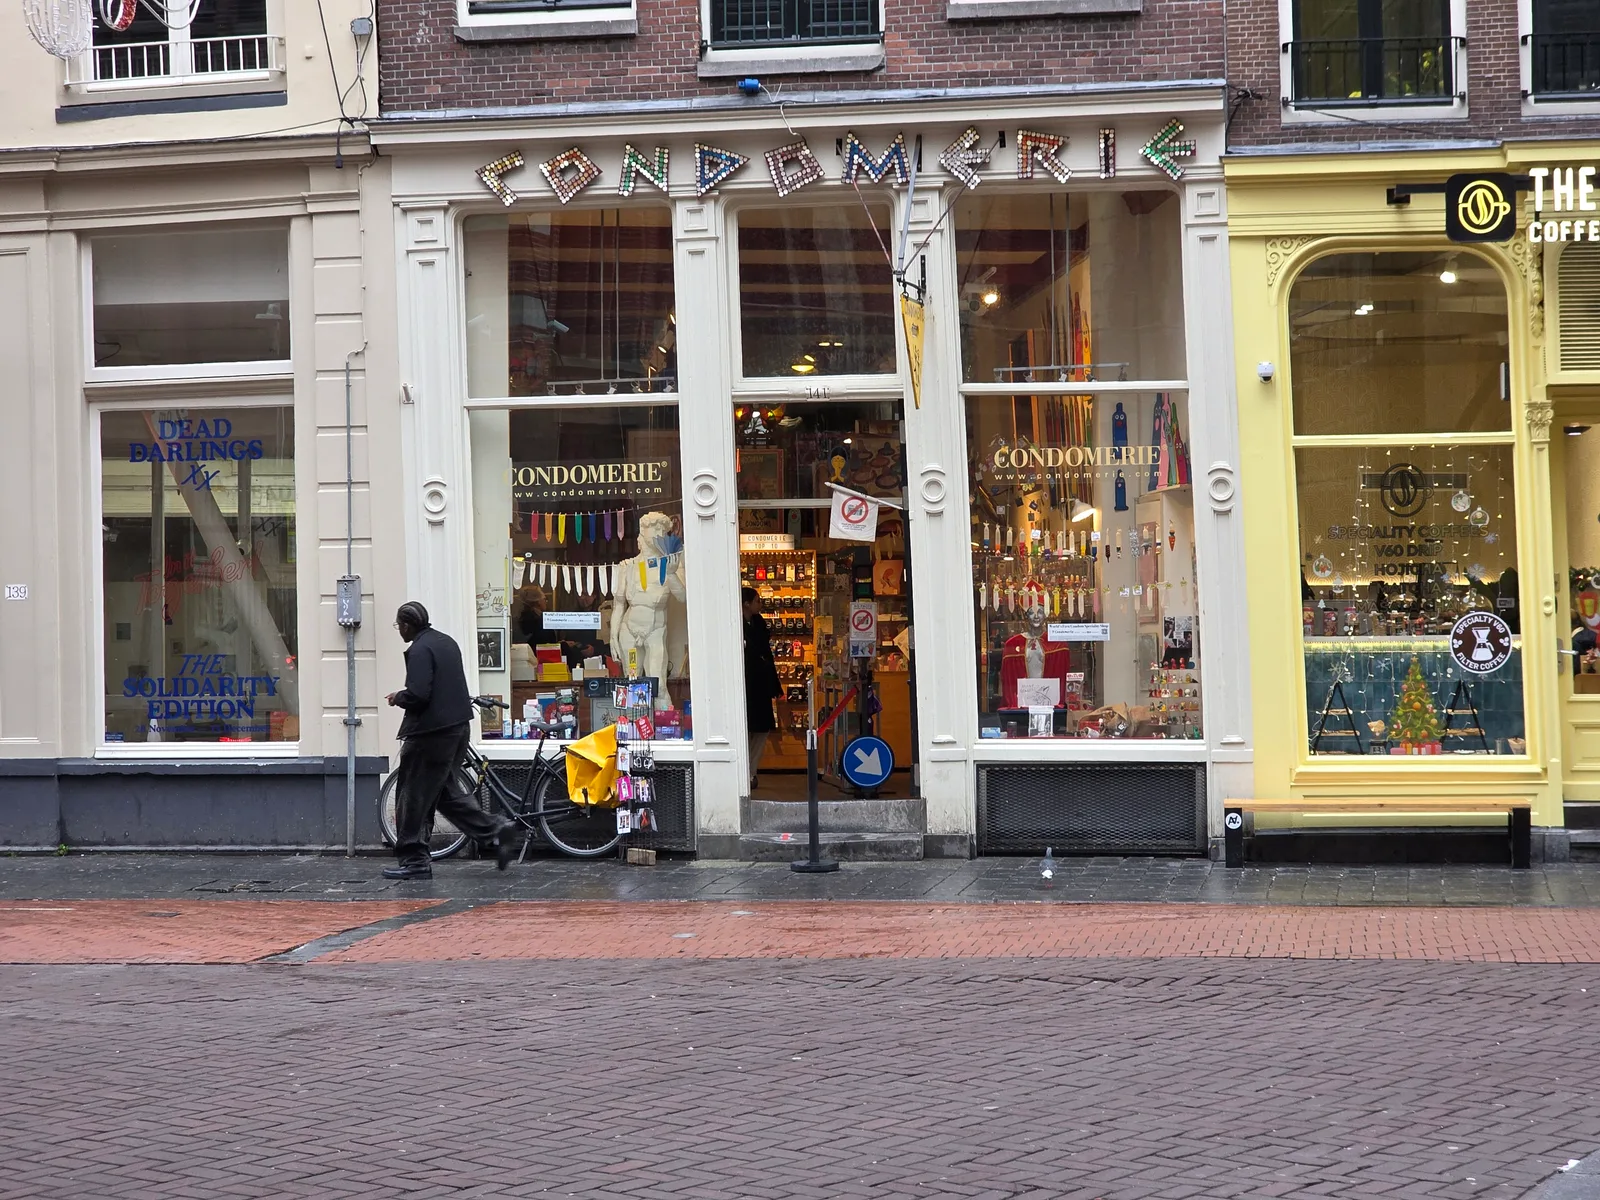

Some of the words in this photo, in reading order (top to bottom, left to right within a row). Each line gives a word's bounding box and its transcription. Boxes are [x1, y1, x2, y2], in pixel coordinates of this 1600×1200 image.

[475, 117, 1196, 207] CONDOMERIE
[1529, 166, 1597, 212] THE
[1529, 220, 1600, 243] COFFE
[807, 387, 828, 399] 141
[158, 418, 232, 440] DEAD
[129, 440, 263, 463] DARLINGS
[994, 445, 1161, 469] CONDOMERIE
[514, 487, 662, 498] ww.condomerie.com
[1328, 525, 1415, 539] SPECIALITY
[1418, 525, 1488, 538] COFFEES
[1374, 544, 1403, 557] V60
[1406, 543, 1444, 556] DRIP
[8, 585, 27, 599] 139
[1456, 616, 1493, 635] SPECIALTY
[1492, 620, 1506, 633] V60
[178, 654, 228, 676] THE
[1456, 652, 1479, 670] FILTER
[1480, 652, 1506, 670] COFFEE
[123, 676, 280, 698] SOLIDARITY
[148, 699, 255, 720] EDITION
